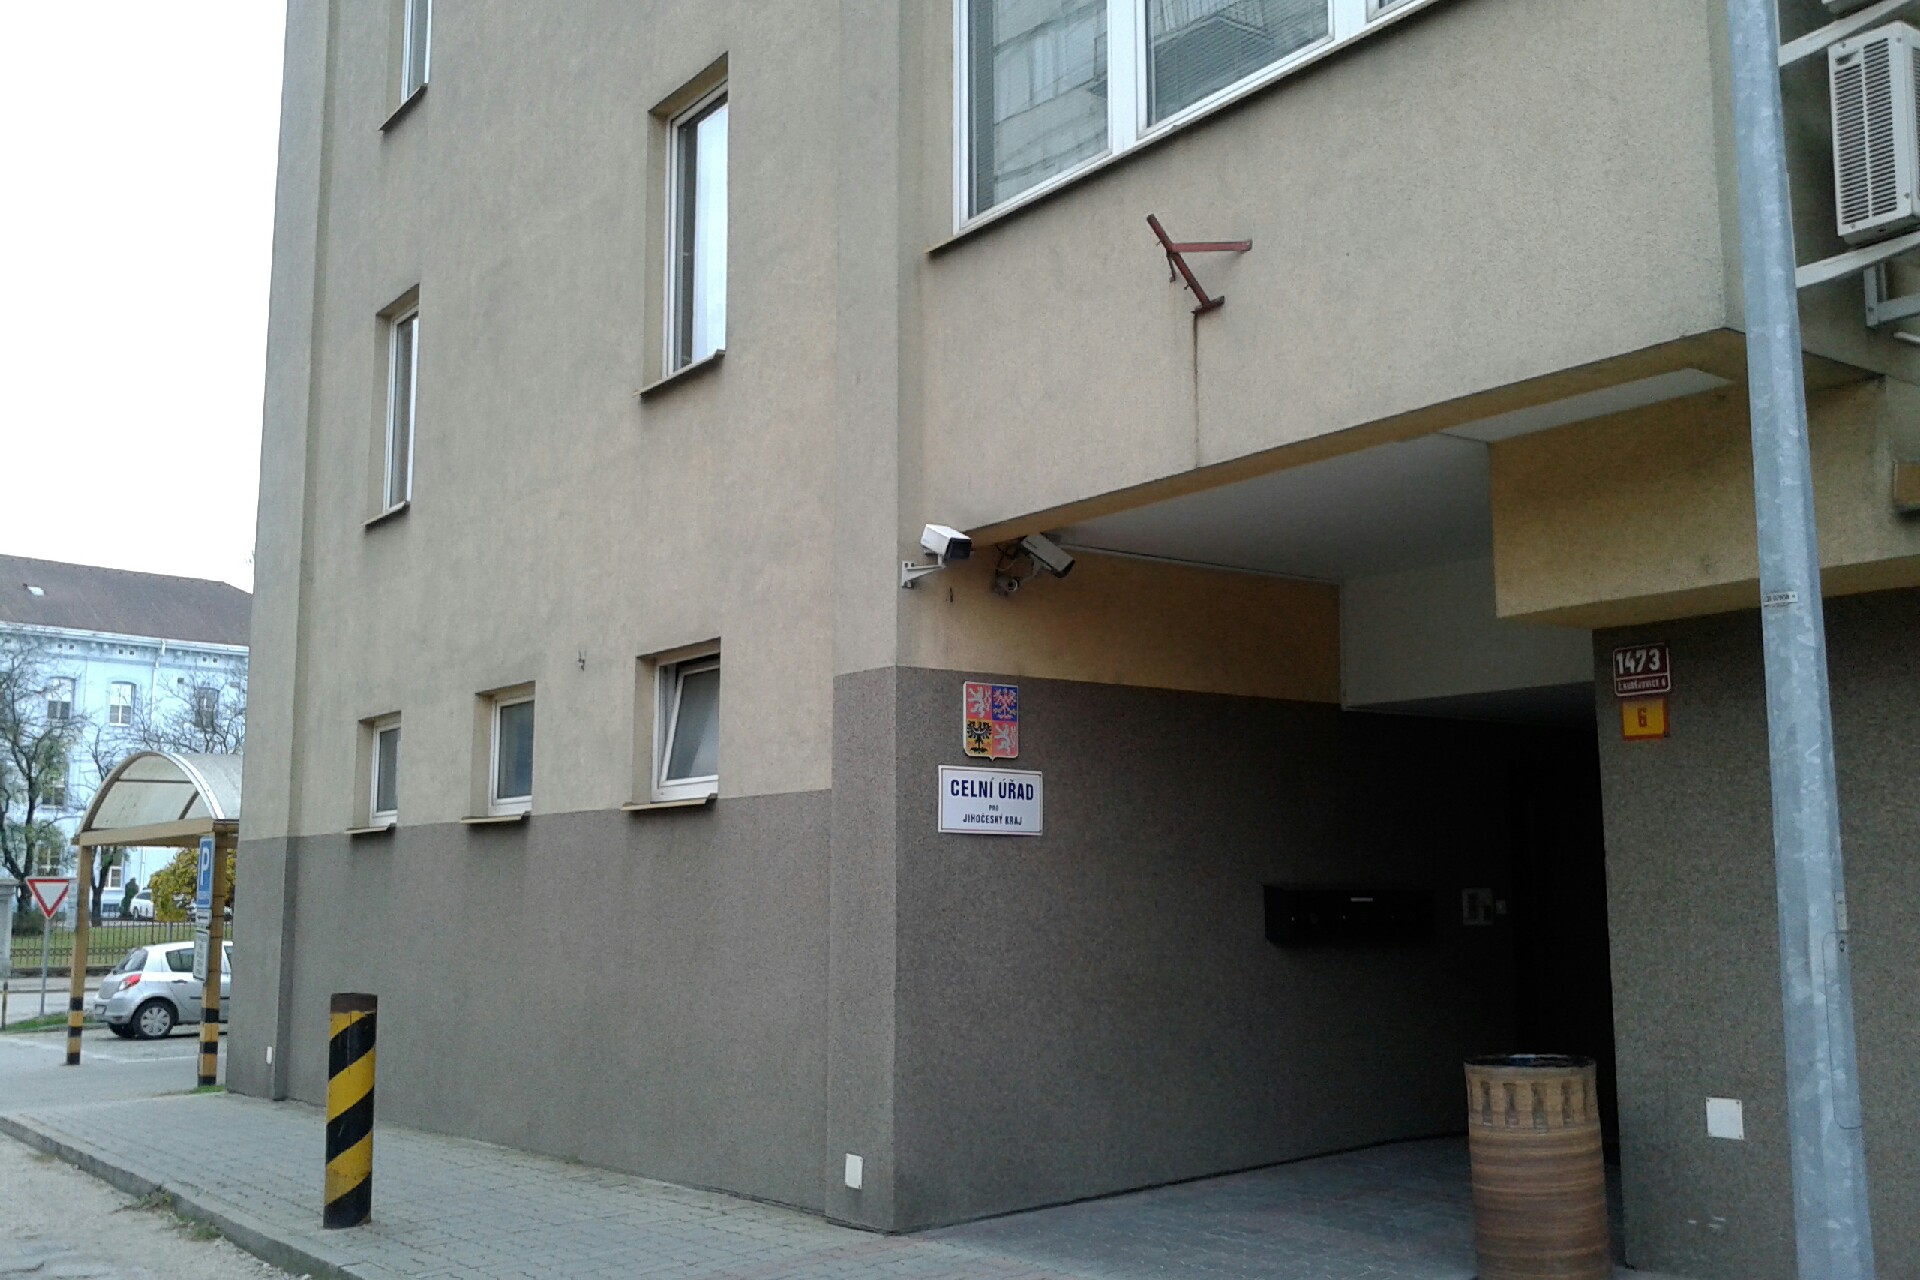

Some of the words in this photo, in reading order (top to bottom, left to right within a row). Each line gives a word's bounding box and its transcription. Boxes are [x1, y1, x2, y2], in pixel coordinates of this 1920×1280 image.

[1616, 647, 1661, 675] 1473
[1637, 707, 1648, 728] 6
[950, 776, 994, 799] CELNÍ
[998, 777, 1034, 801] ÚŘAD
[962, 812, 1003, 825] JIHOČESKÝ
[1004, 815, 1023, 826] KRAJ
[199, 846, 210, 886] P
